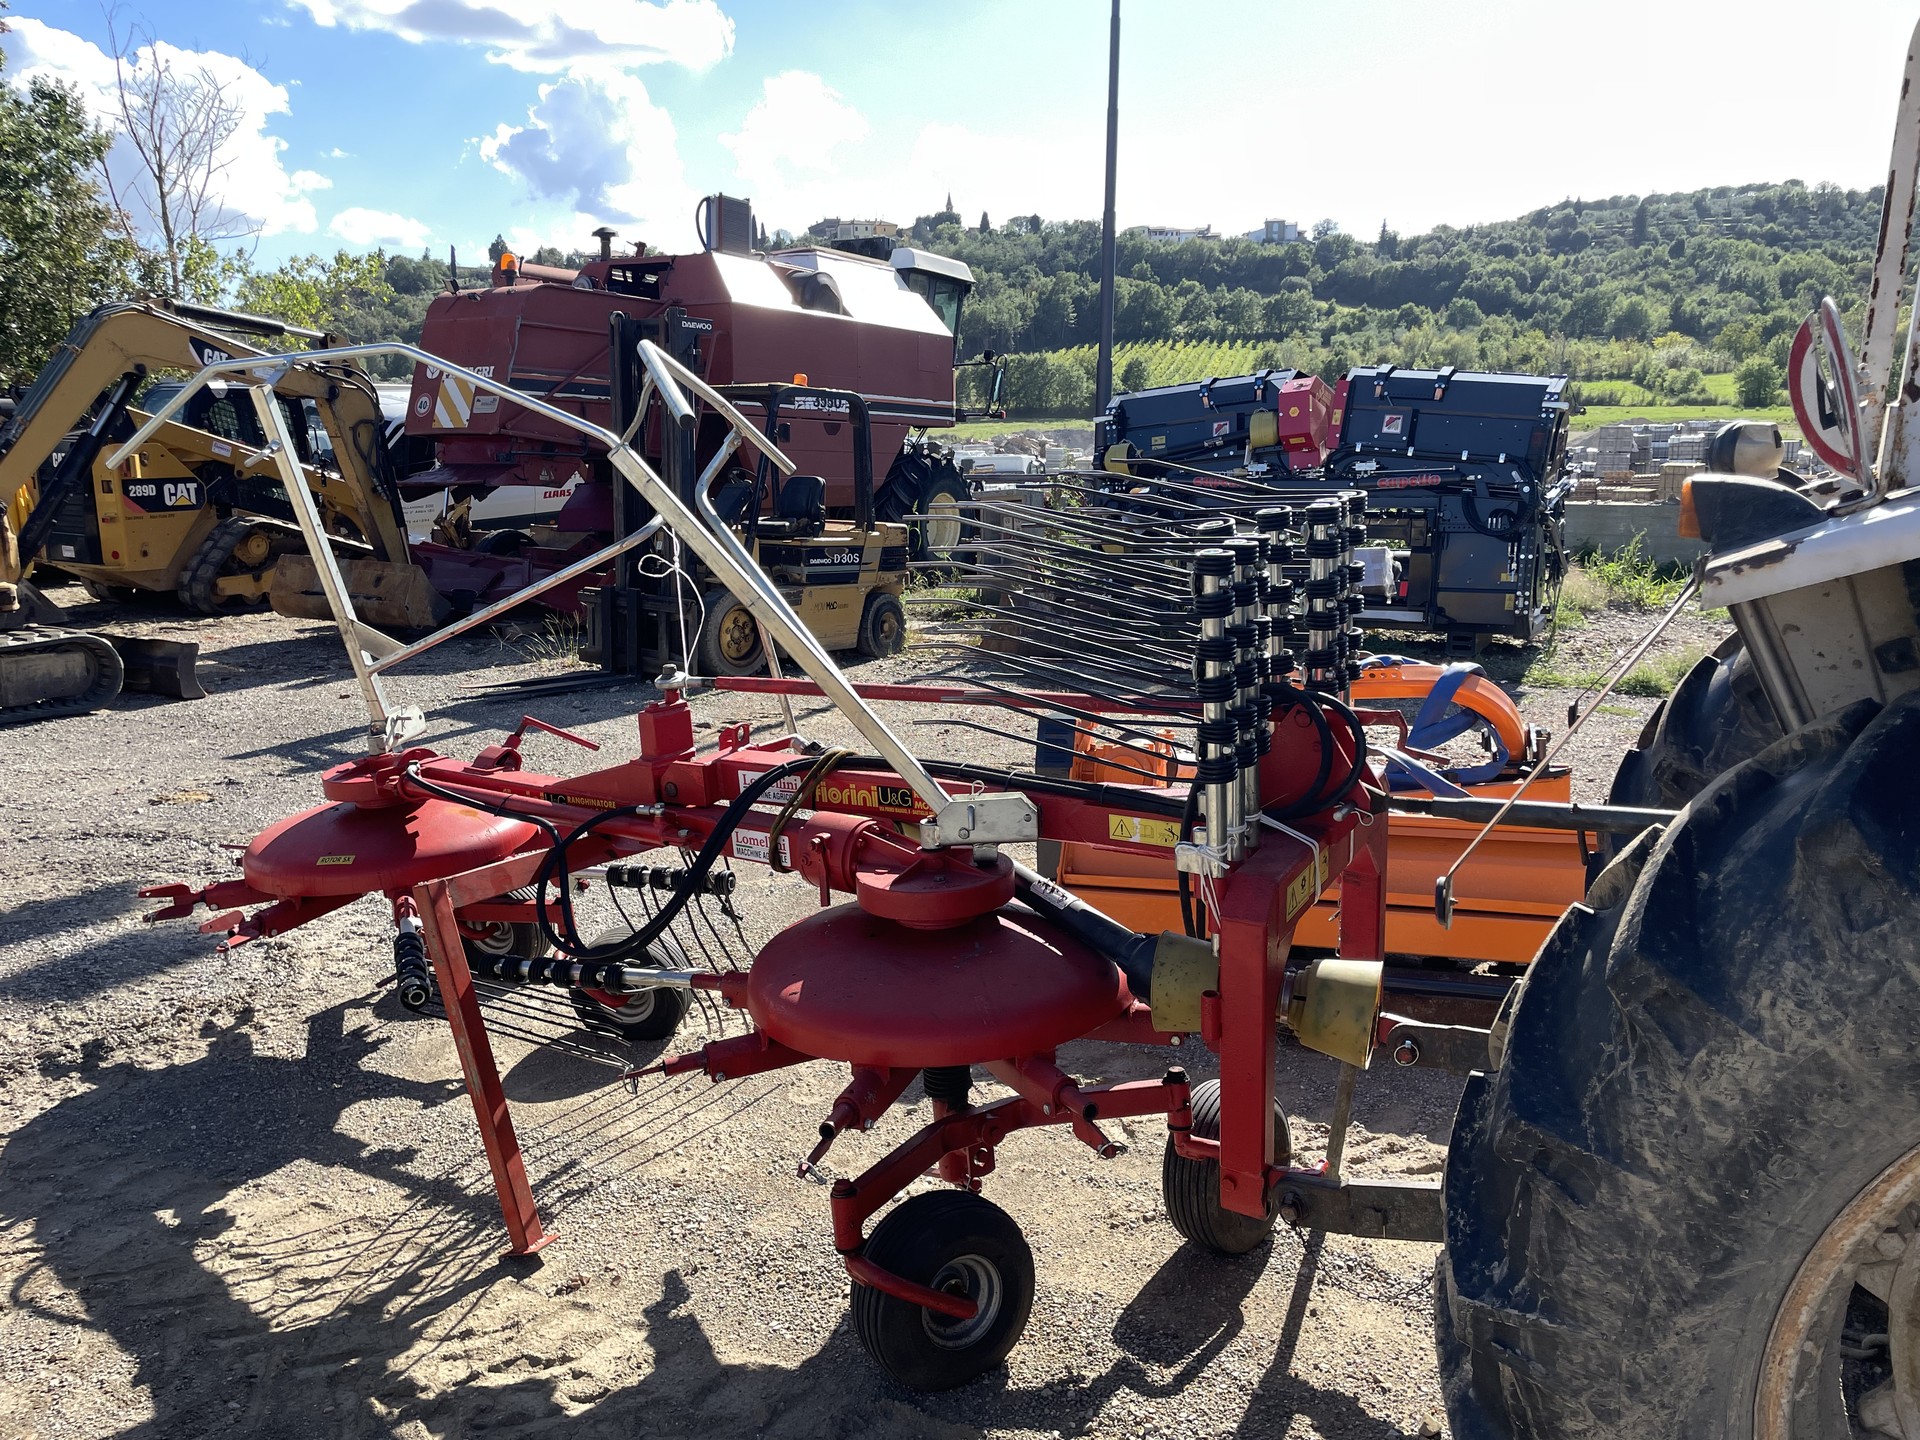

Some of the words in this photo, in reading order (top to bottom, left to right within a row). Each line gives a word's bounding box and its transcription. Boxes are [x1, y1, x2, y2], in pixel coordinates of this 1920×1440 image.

[681, 320, 713, 331] DAEWOO
[418, 400, 428, 410] 40
[128, 485, 157, 497] 289D
[163, 482, 198, 507] CAT
[543, 489, 572, 500] CLAAS
[833, 553, 860, 564] D30S
[815, 781, 879, 808] fiorini
[878, 786, 912, 807] U&G
[566, 795, 617, 809] RANGHINATORE
[736, 846, 762, 859] MACCHINE
